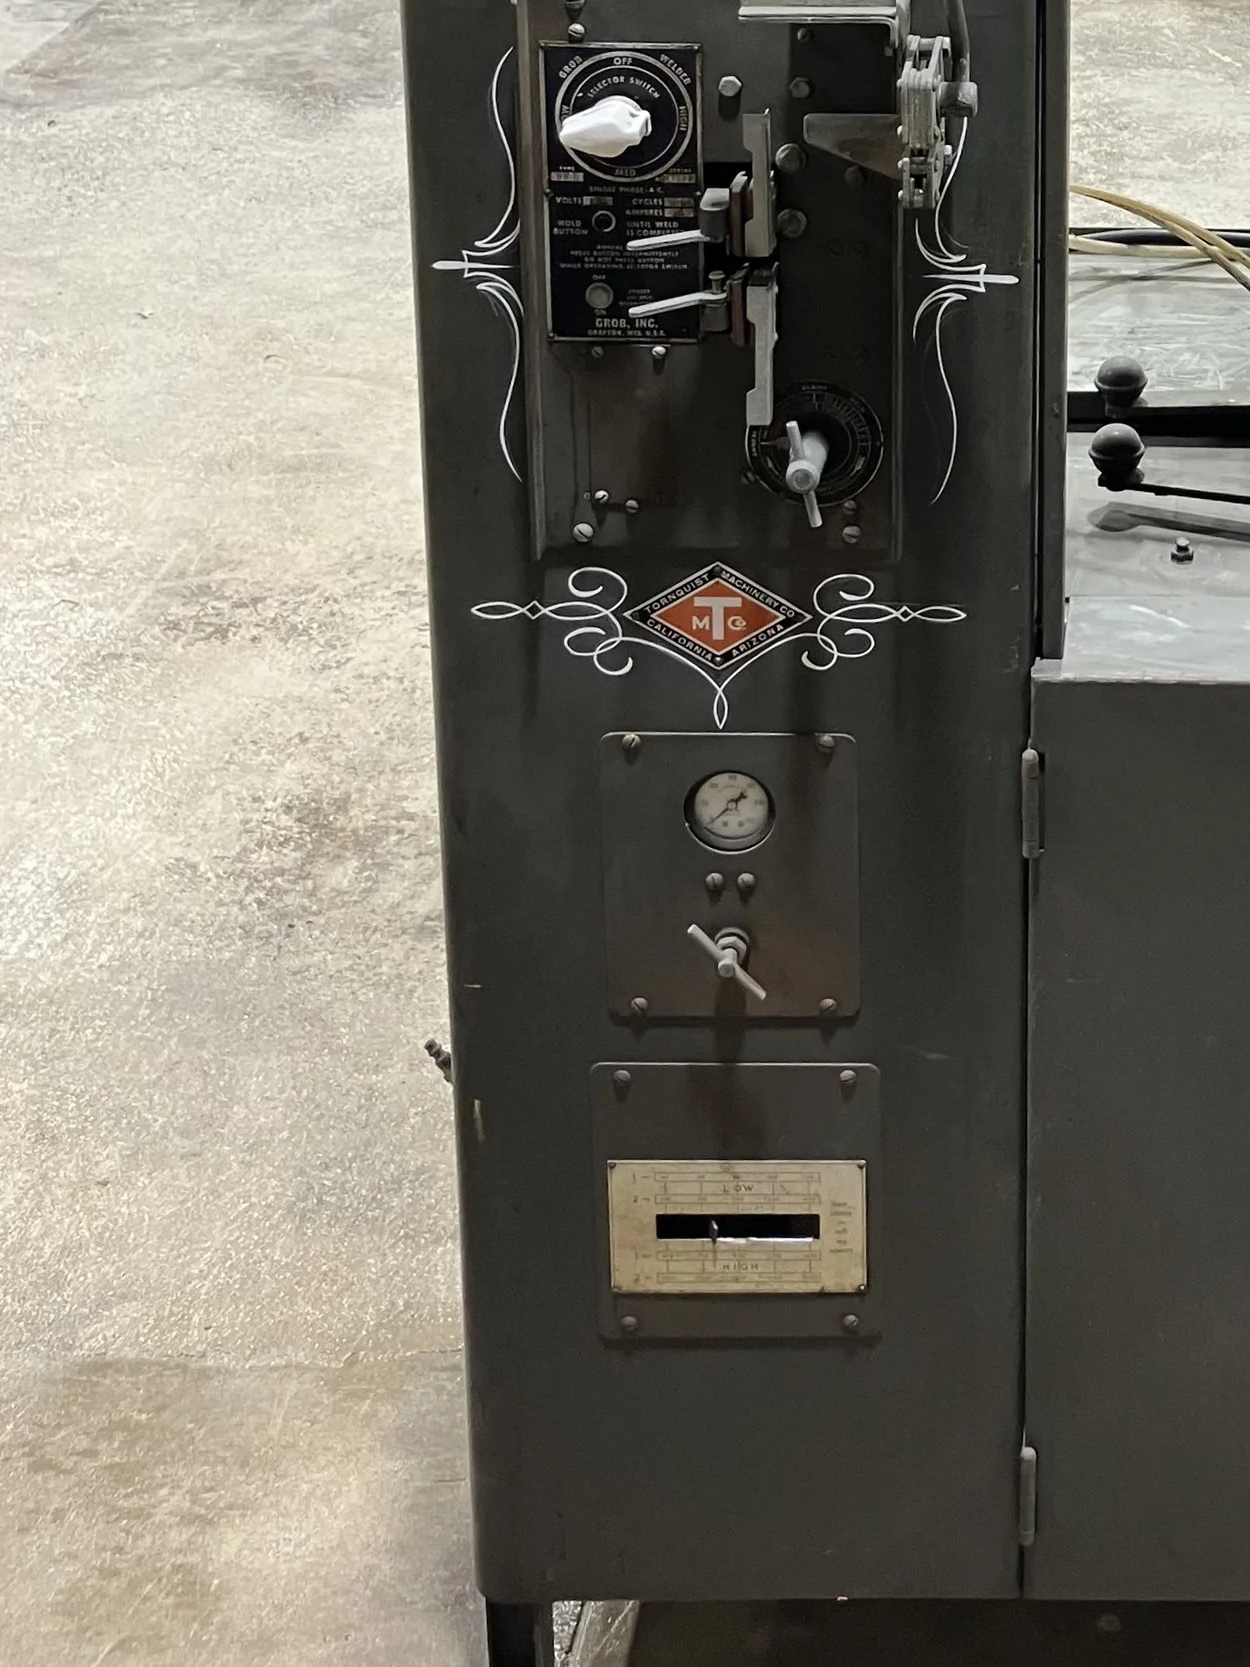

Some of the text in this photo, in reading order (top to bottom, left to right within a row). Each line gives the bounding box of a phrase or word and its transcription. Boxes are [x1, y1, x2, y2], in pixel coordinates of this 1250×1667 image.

[613, 57, 633, 66] OFF
[659, 54, 692, 86] WELDER
[587, 76, 661, 99] SELECTOR SWITCH
[678, 105, 689, 131] HIGH
[555, 197, 582, 205] VOLTS
[631, 198, 663, 206] CYCLES
[595, 318, 659, 329] GROB, INC.
[644, 574, 710, 614] TORNQUIST
[720, 570, 779, 611] MACHINERY
[646, 618, 713, 662] CALIFORNIA
[731, 623, 785, 657] ARIZONA
[722, 1183, 754, 1192] LOW
[722, 1262, 759, 1271] HIGH
